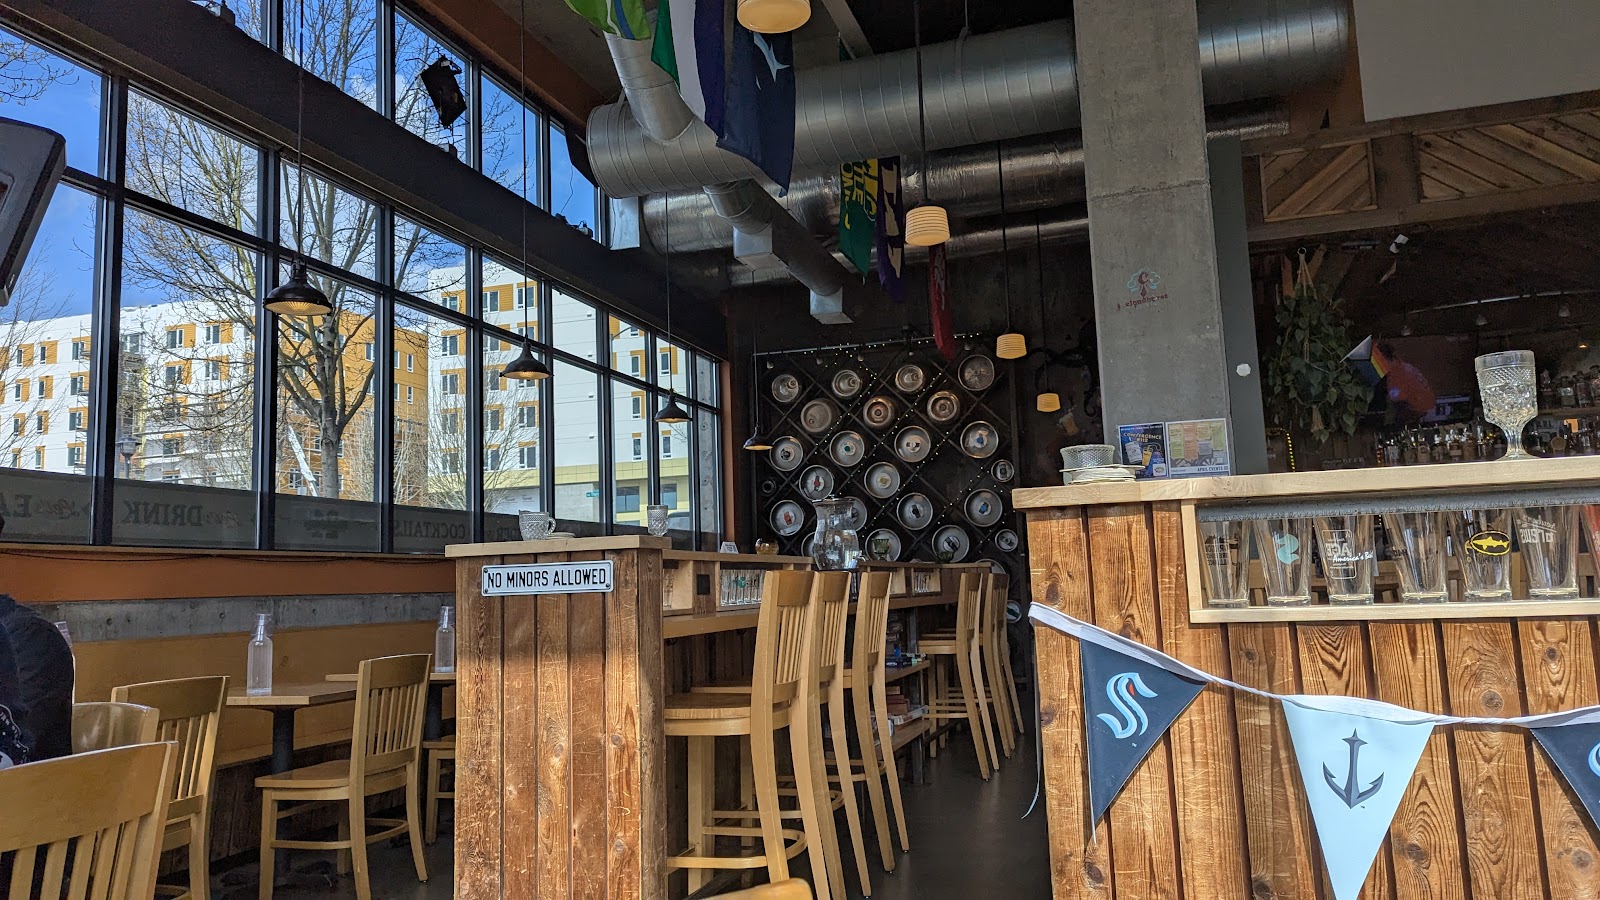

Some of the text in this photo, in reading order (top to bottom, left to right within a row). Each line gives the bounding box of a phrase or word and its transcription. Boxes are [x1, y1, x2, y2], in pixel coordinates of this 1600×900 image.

[1332, 552, 1364, 563] America's
[487, 568, 607, 588] NO MINORS ALLOWED
